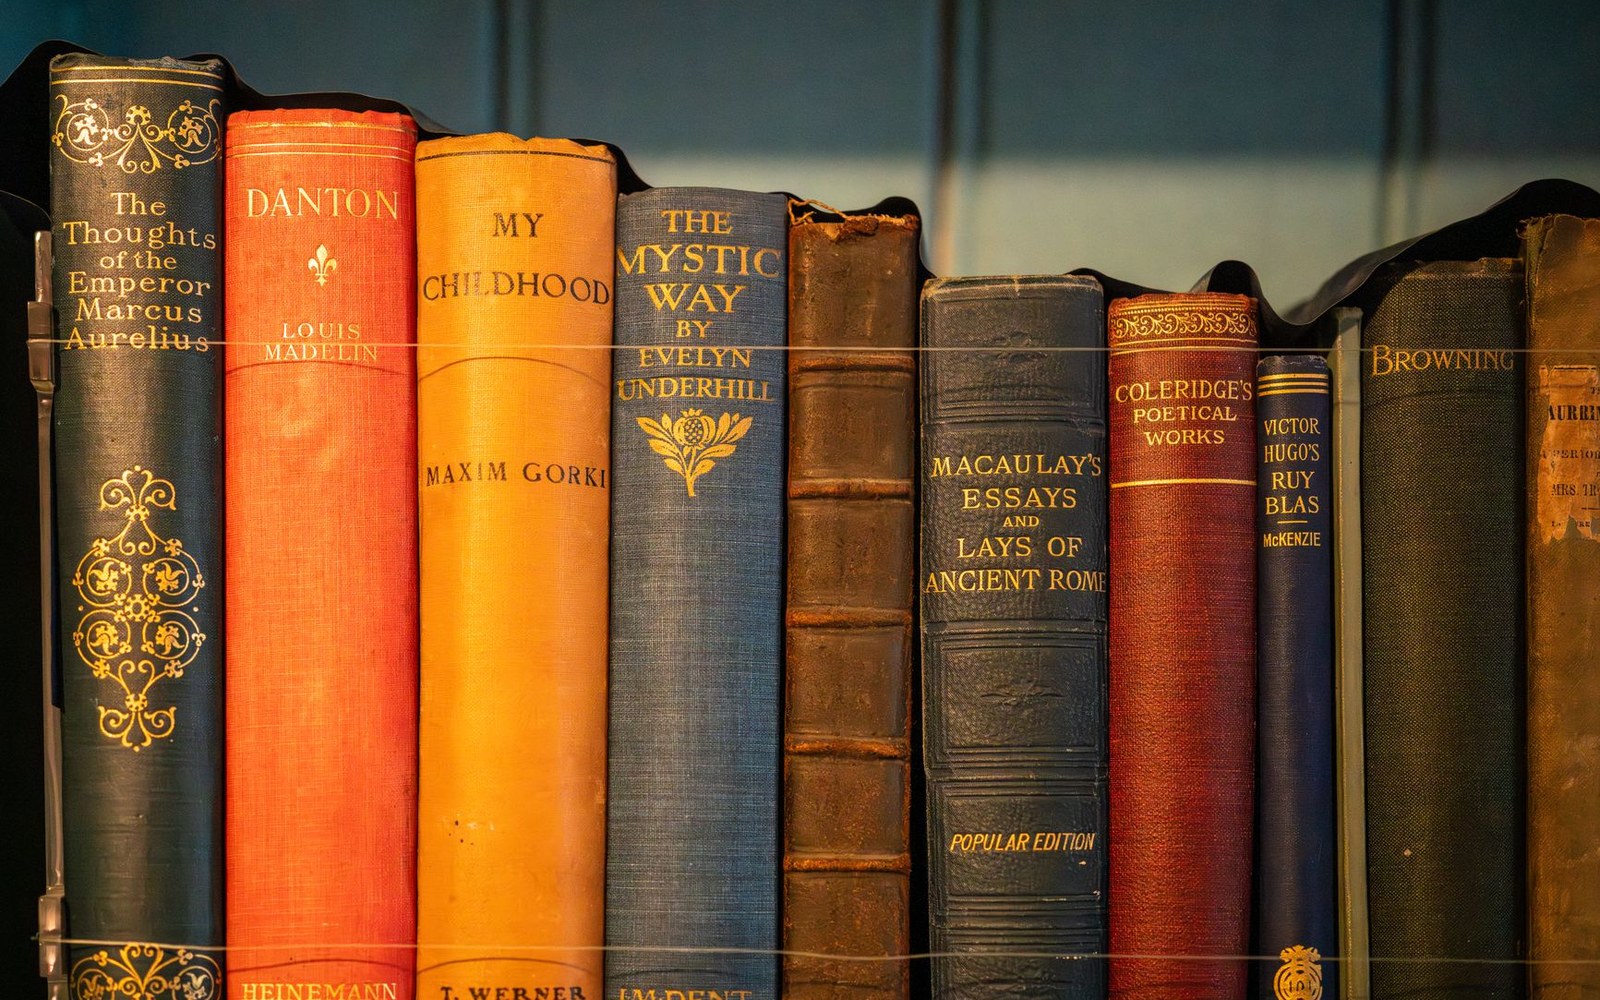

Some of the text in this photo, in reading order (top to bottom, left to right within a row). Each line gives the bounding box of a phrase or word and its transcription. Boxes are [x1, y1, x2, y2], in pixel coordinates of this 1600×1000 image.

[110, 192, 167, 217] The
[247, 188, 398, 220] DANTON
[493, 212, 544, 238] MY
[661, 209, 734, 234] THE
[63, 221, 217, 250] Thoughts
[100, 251, 177, 270] of the
[616, 244, 781, 278] MYSTIC
[68, 271, 211, 298] Emperor
[423, 271, 610, 305] CHILDHOOD
[644, 283, 746, 313] WAY
[75, 298, 202, 323] Marcus
[64, 326, 209, 352] Aurelius
[283, 322, 360, 340] LOUIS
[676, 319, 713, 338] BY
[264, 343, 378, 361] MADELIN
[639, 346, 752, 368] EVELYN
[617, 377, 775, 402] UNDERHILL
[1115, 380, 1253, 402] COLERIDGE'S
[1133, 406, 1238, 423] POETICAL
[1264, 417, 1321, 436] VICTOR
[1144, 430, 1225, 446] WORKS
[1264, 443, 1320, 464] HUGO'S
[426, 462, 606, 489] MAXIM GORKI
[931, 453, 1101, 478] MACAULAY'S
[1271, 471, 1315, 490] RUY
[961, 487, 1077, 510] ESSAYS
[1265, 496, 1320, 516] BLAS
[1003, 515, 1040, 528] AND
[956, 536, 1083, 559] LAYS OF
[1263, 532, 1321, 548] McKENZIE
[924, 569, 1106, 593] ANCIENT ROME
[950, 832, 1096, 852] POPULAR EDITION
[242, 983, 396, 1000] HEINEMANN
[469, 987, 586, 1000] WERNER
